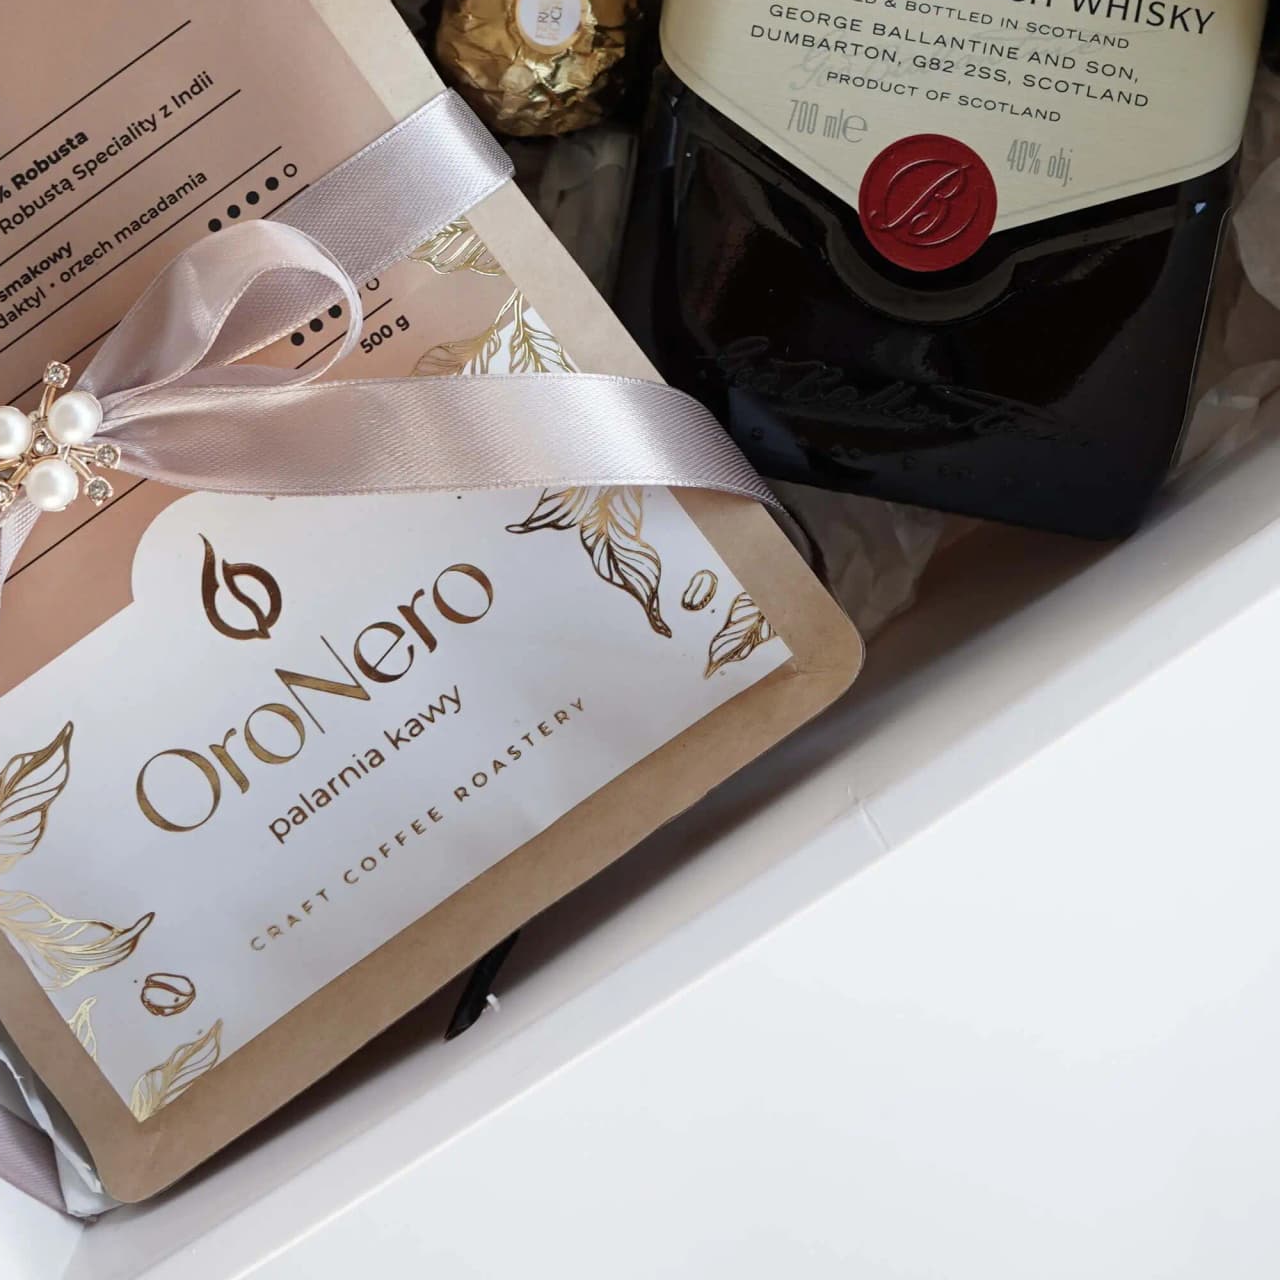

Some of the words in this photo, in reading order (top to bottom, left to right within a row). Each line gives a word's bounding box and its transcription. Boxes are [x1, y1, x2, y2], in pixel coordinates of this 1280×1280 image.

[769, 3, 863, 33] GEORGE
[872, 22, 1020, 61] BALLANTINE
[1027, 51, 1076, 70] AND
[1085, 60, 1138, 84] SON,
[904, 0, 993, 25] BOTTLED
[1000, 17, 1019, 30] IN
[1025, 21, 1130, 49] SCOTLAND
[750, 24, 902, 66] DUMBARTON,
[912, 54, 955, 74] G82
[963, 63, 1012, 86] 2SS,
[1022, 74, 1149, 107] SCOTLAND
[826, 71, 919, 97] PRODUCT
[925, 89, 951, 102] OF
[957, 95, 1061, 122] SCOTLAND
[72, 113, 157, 181] Speciality
[158, 104, 173, 119] z
[170, 70, 214, 109] Indii
[786, 98, 820, 136] 700
[10, 131, 89, 191] Robusta
[1006, 138, 1042, 176] 40%
[1046, 147, 1073, 188] obj.
[59, 240, 114, 283] orzech
[113, 172, 208, 244] macadamia
[359, 324, 394, 354] 500
[395, 314, 410, 332] g
[135, 563, 494, 833] OroNero
[268, 748, 386, 845] palarnia
[383, 685, 462, 751] kawy
[250, 887, 329, 951] CRAFT
[343, 806, 444, 885] COFFEE
[453, 697, 583, 803] ROASTERY
